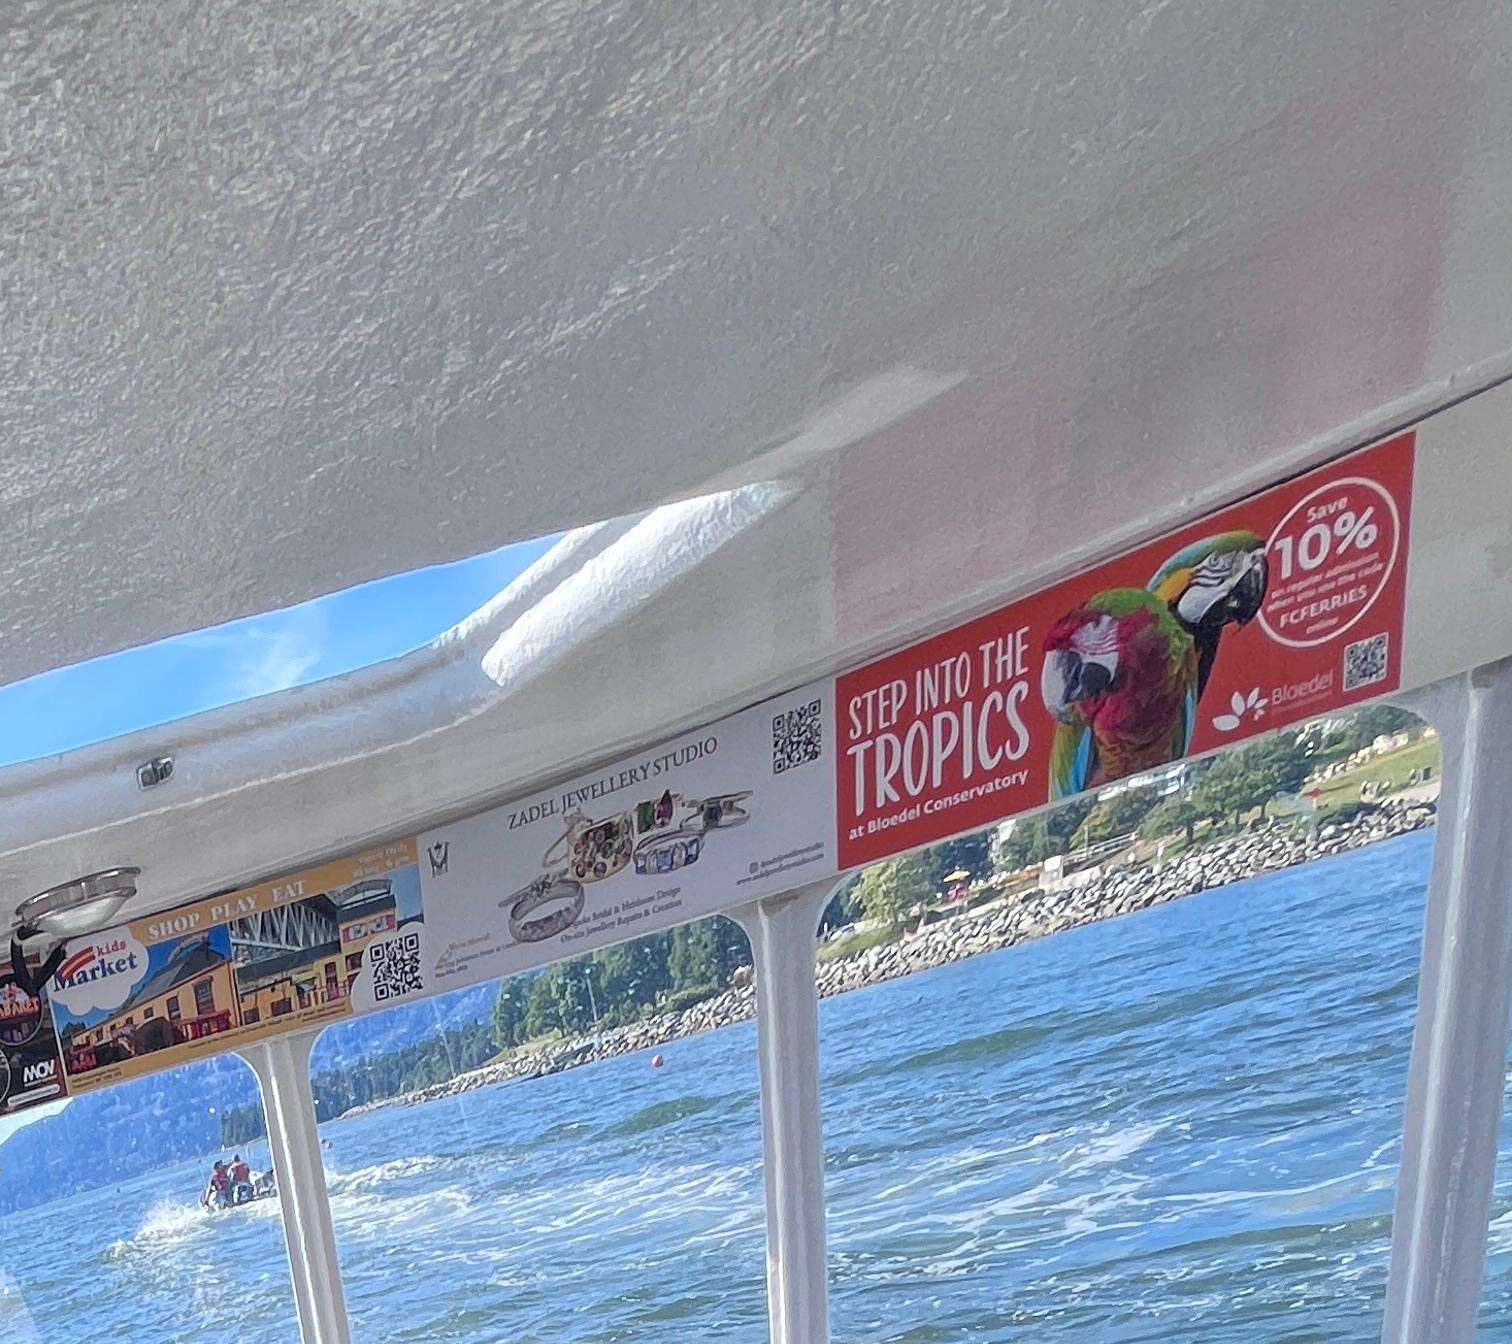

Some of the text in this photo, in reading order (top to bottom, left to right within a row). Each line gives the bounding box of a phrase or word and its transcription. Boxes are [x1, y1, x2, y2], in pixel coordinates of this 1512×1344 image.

[1307, 496, 1348, 524] Save
[1274, 506, 1378, 580] 10%
[1279, 584, 1368, 629] FCFERRIES
[849, 626, 1030, 740] STEP INTO THE
[1271, 669, 1334, 706] Bloedel
[846, 680, 1030, 816] TROPICS
[508, 736, 718, 830] ZADEL JEWELLERY STUDIO
[848, 769, 1029, 840] at Bloedel Conservatory
[147, 880, 306, 941] SHOP PLAY EAT
[53, 952, 138, 993] Market
[96, 940, 126, 957] kids
[23, 1059, 55, 1083] MOV
